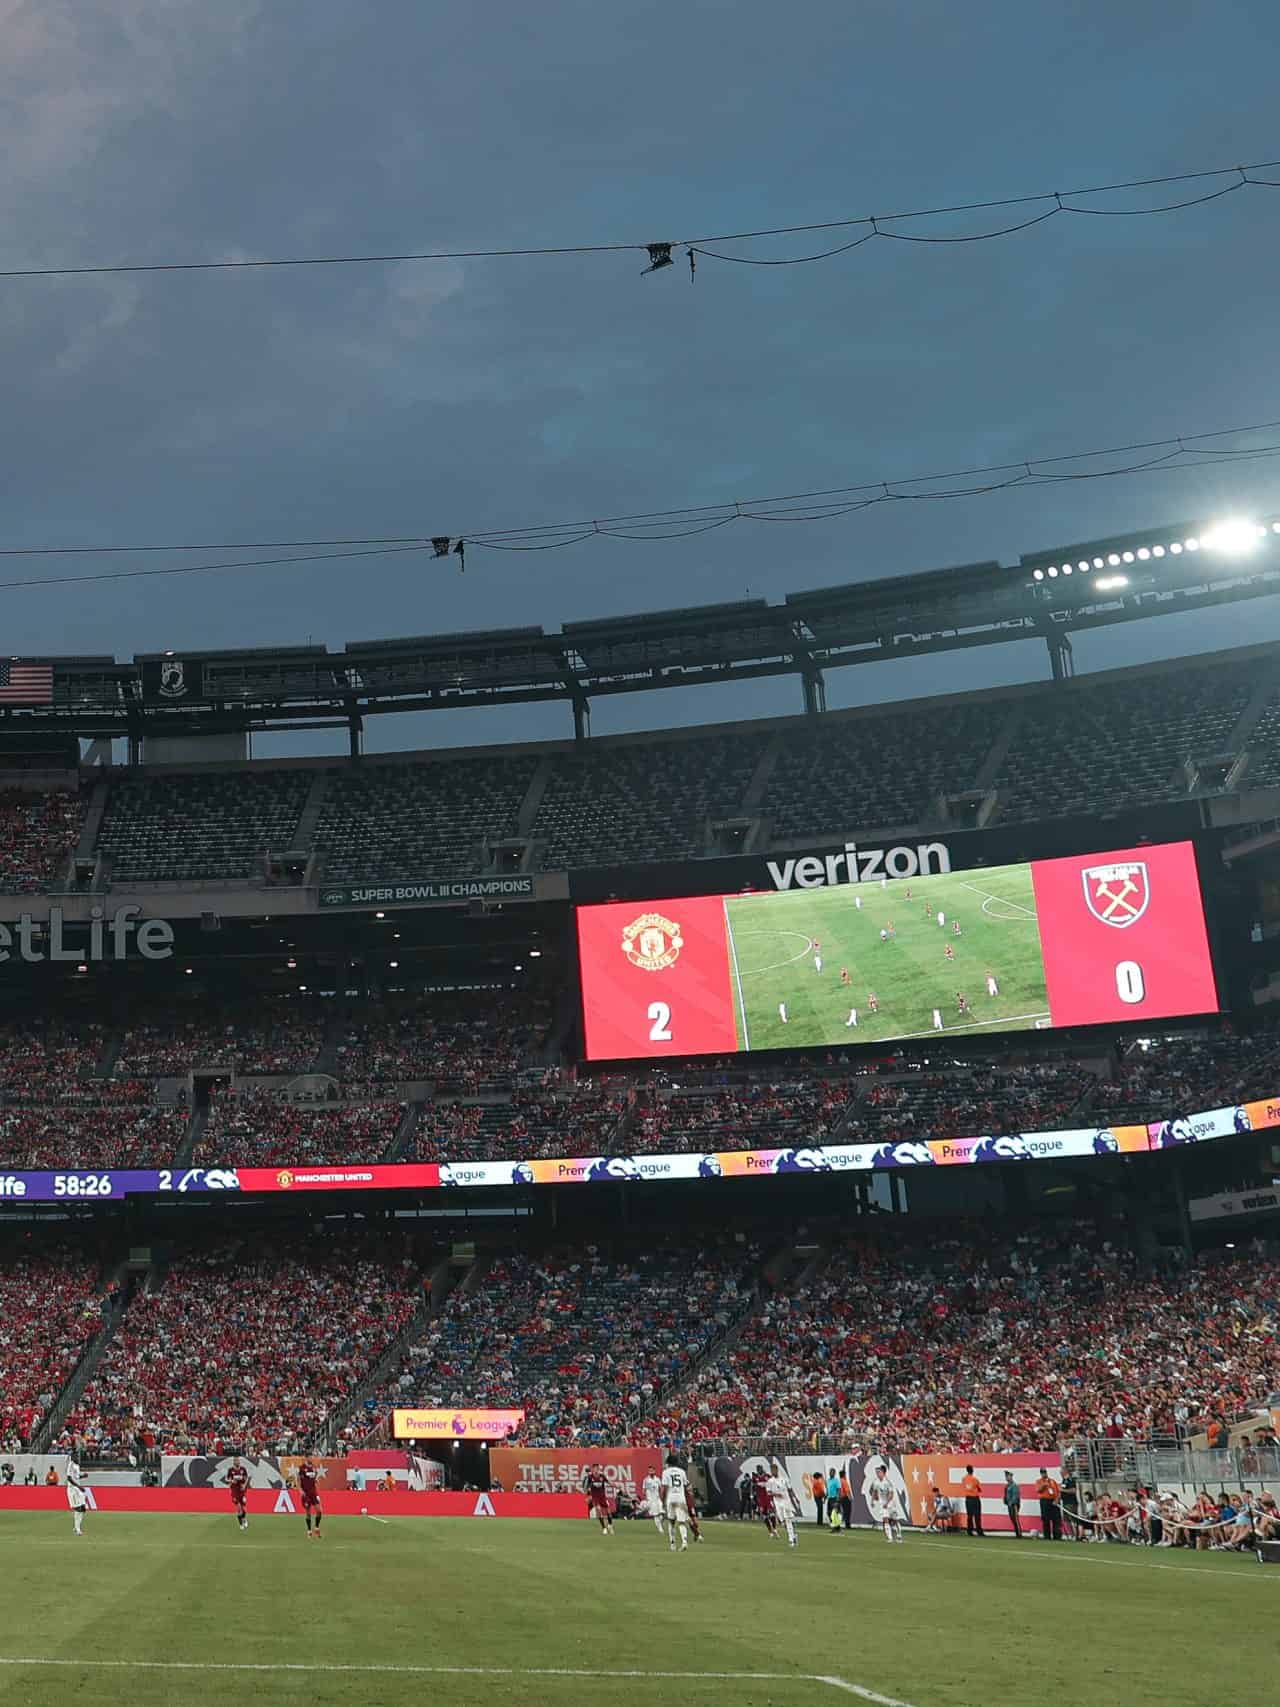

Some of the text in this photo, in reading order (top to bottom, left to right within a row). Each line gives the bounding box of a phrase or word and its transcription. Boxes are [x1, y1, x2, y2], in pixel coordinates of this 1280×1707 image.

[767, 842, 952, 890] verizon
[351, 888, 393, 901] SUPER
[396, 885, 438, 898] BOWL
[439, 885, 450, 897] III
[451, 879, 531, 896] CHAMPIONS
[1115, 960, 1146, 1004] 0
[648, 1001, 673, 1041] 2
[53, 1176, 112, 1195] 58:26
[158, 1171, 172, 1190] 2
[406, 1418, 448, 1430] Premier
[519, 1464, 632, 1481] THE SEAON
[671, 1474, 682, 1488] 15
